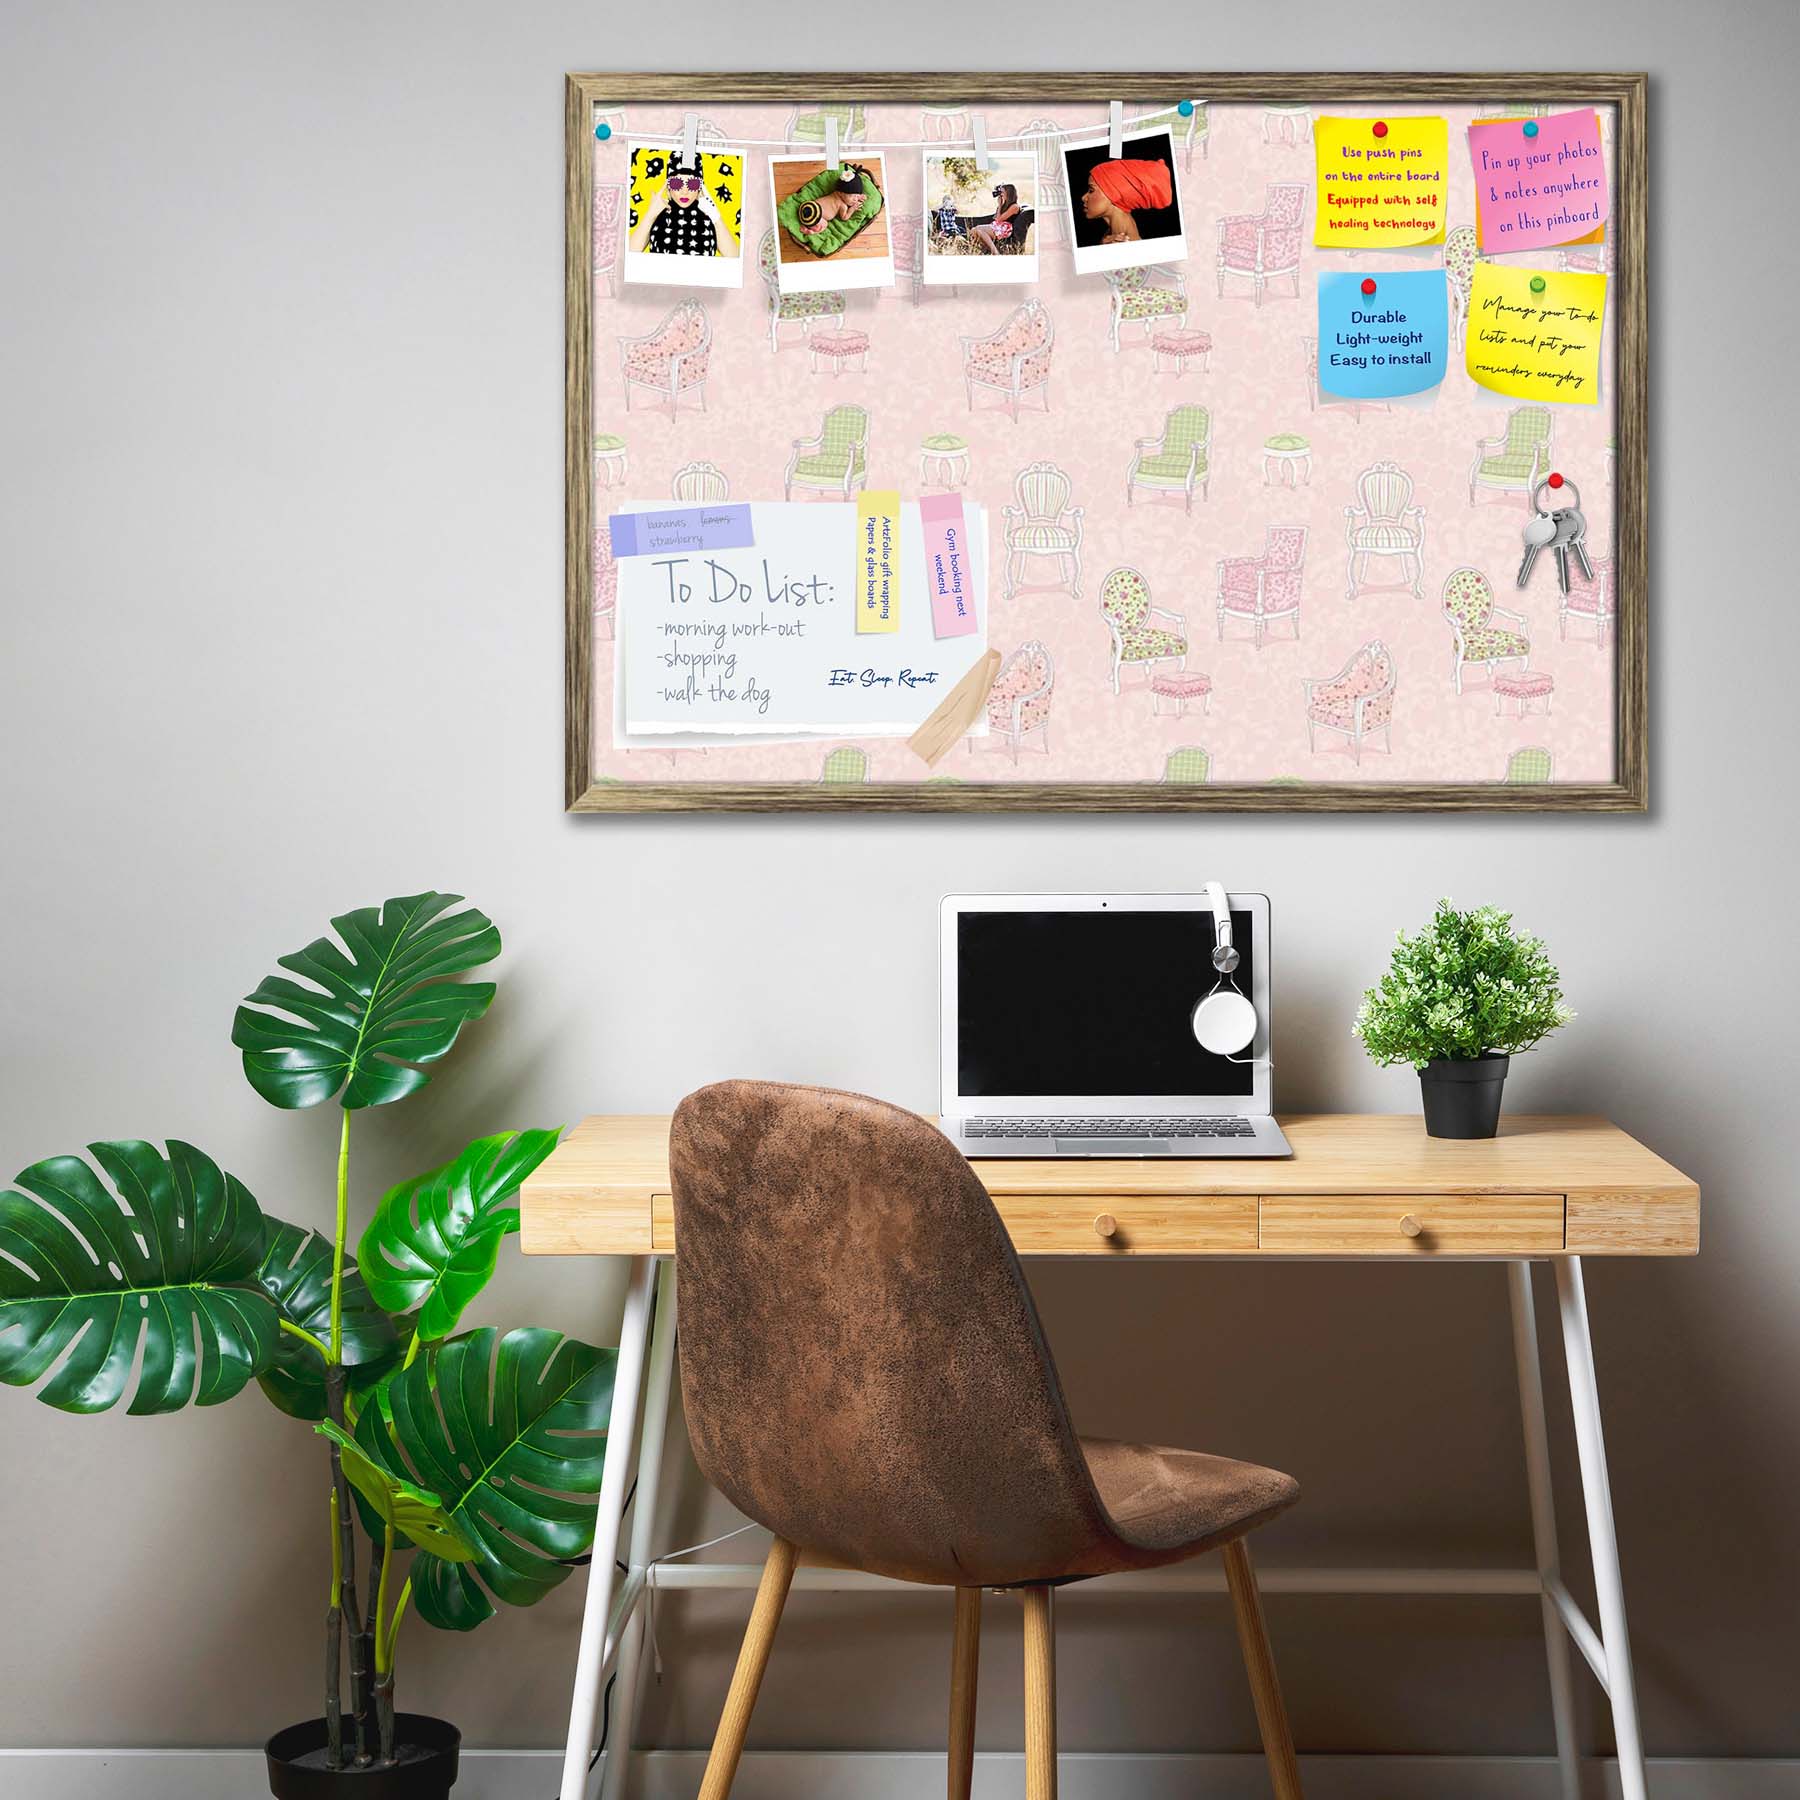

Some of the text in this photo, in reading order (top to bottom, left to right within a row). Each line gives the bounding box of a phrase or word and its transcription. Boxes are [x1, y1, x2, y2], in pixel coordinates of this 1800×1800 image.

[1342, 146, 1422, 161] Use push pins
[1482, 141, 1598, 171] Pin up your photos
[1325, 171, 1440, 181] on the entire board
[1490, 174, 1599, 202] & notes anywhere
[1327, 194, 1438, 208] Equipped with self
[1329, 218, 1436, 231] healing technology
[1500, 202, 1599, 233] on this pinboard
[1352, 311, 1407, 323] Durable
[1483, 295, 1537, 319] Manage
[1538, 309, 1565, 322] your
[1336, 332, 1423, 348] Light-weight
[1511, 336, 1536, 347] and
[1538, 336, 1562, 352] put
[1559, 343, 1586, 355] your
[1330, 352, 1432, 368] Easy to install
[1476, 364, 1584, 389] reminders everyday
[866, 517, 876, 545] Papers
[865, 557, 877, 577] glass
[880, 516, 892, 619] ArtzFolio gift wrapping
[934, 554, 949, 595] weekend
[945, 528, 966, 617] Gym booking next
[652, 559, 835, 607] To Do List:
[867, 579, 877, 609] boards
[732, 612, 806, 637] work-out
[708, 675, 737, 702] the
[741, 677, 772, 714] dog
